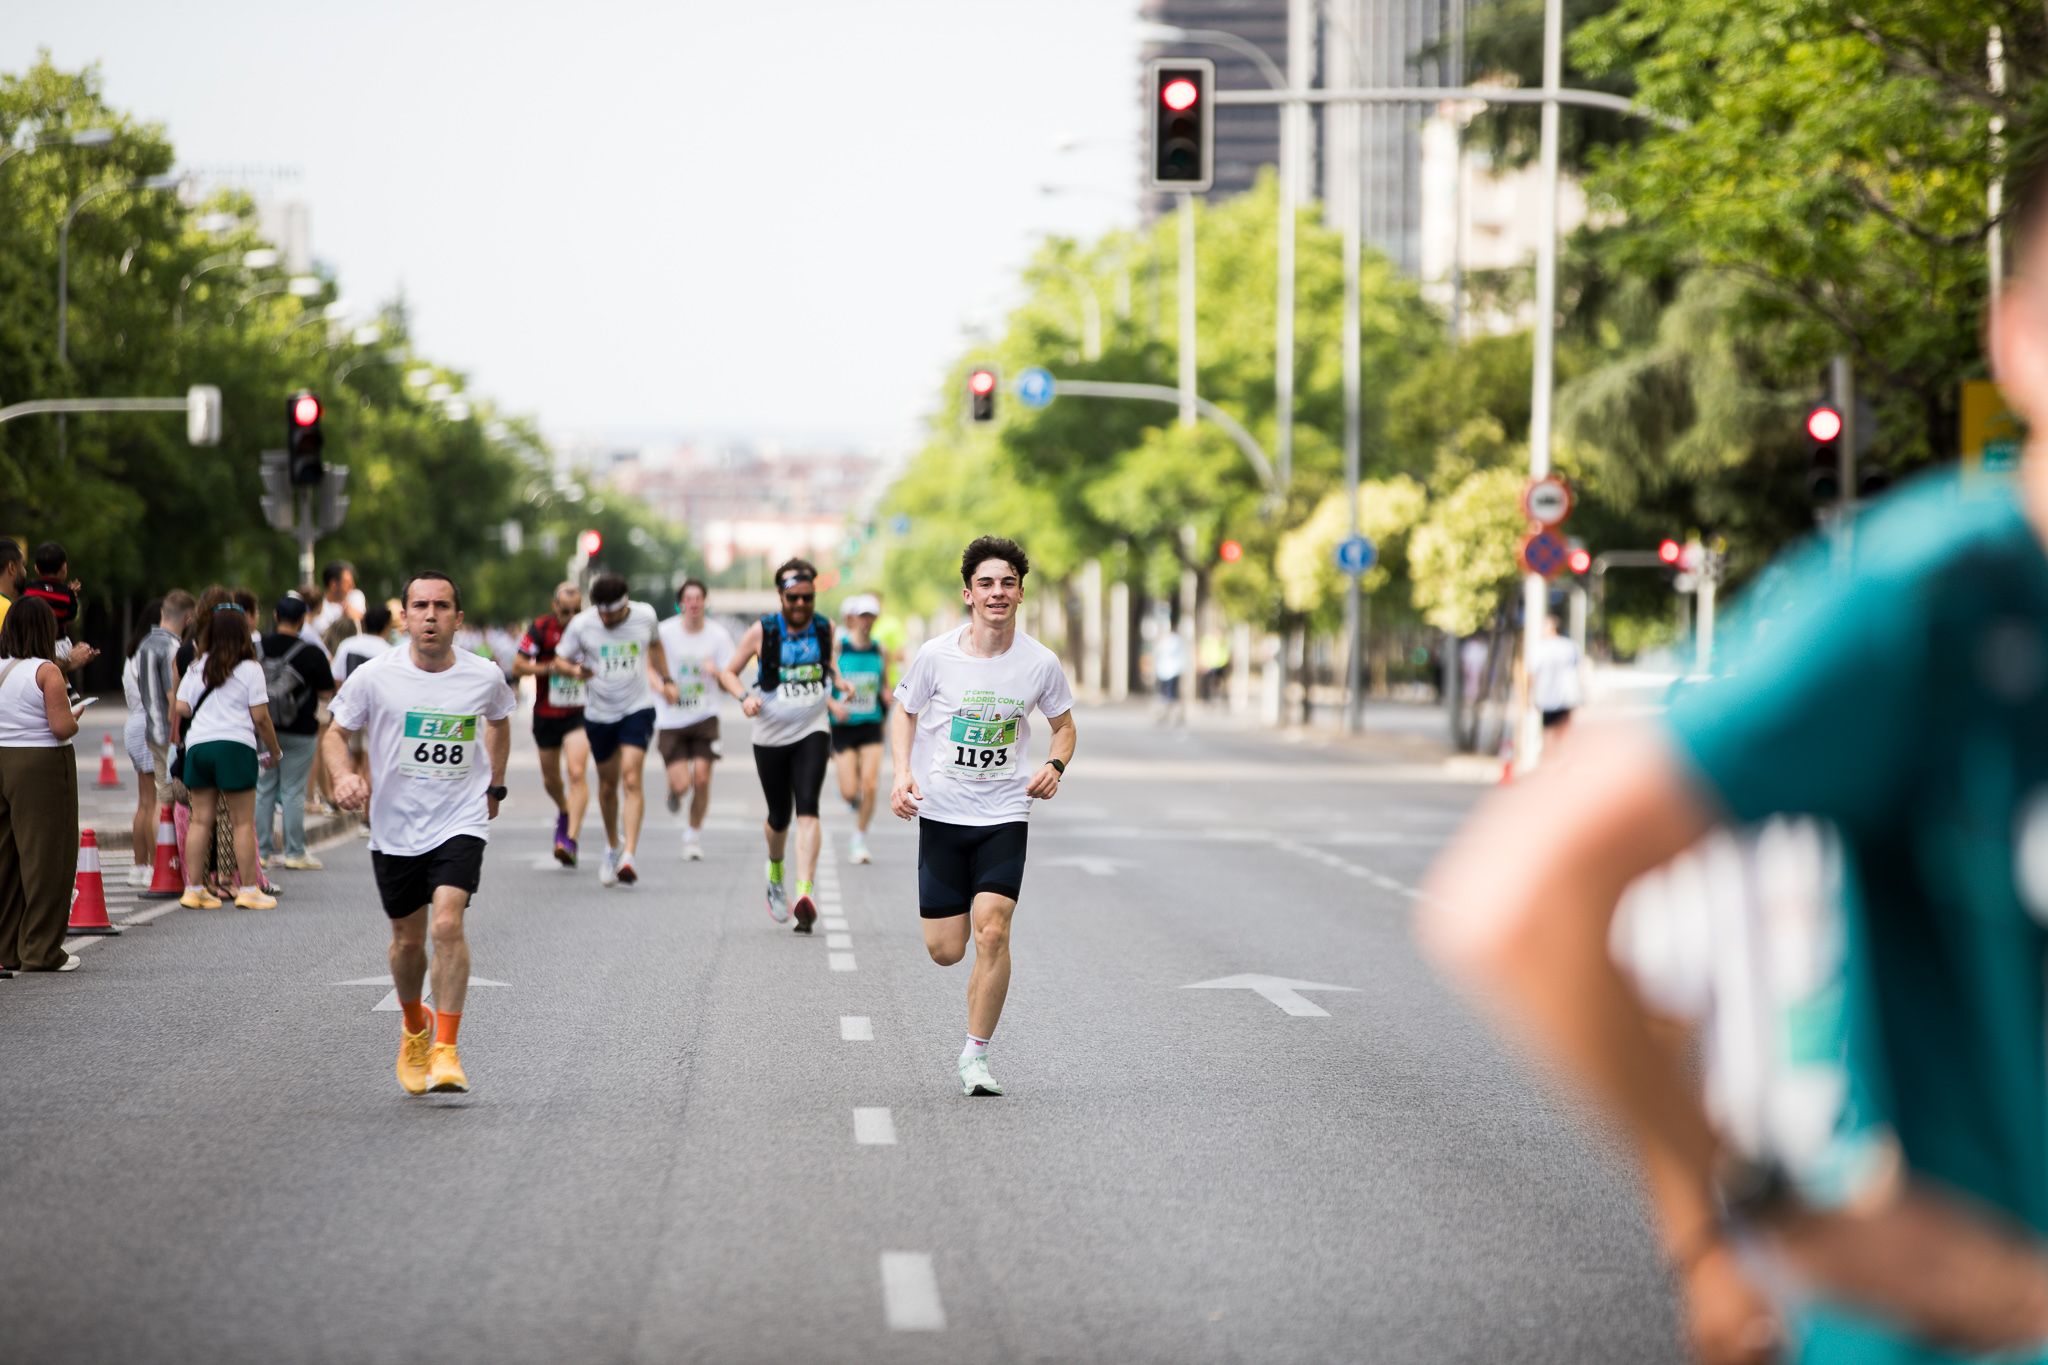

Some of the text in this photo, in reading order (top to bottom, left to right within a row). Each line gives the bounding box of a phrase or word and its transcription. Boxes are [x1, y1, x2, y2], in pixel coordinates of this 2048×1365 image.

[997, 697, 1015, 705] CON
[418, 719, 464, 739] ELA
[963, 726, 1004, 744] ELA
[414, 742, 463, 765] 688
[954, 745, 1008, 768] 1193
